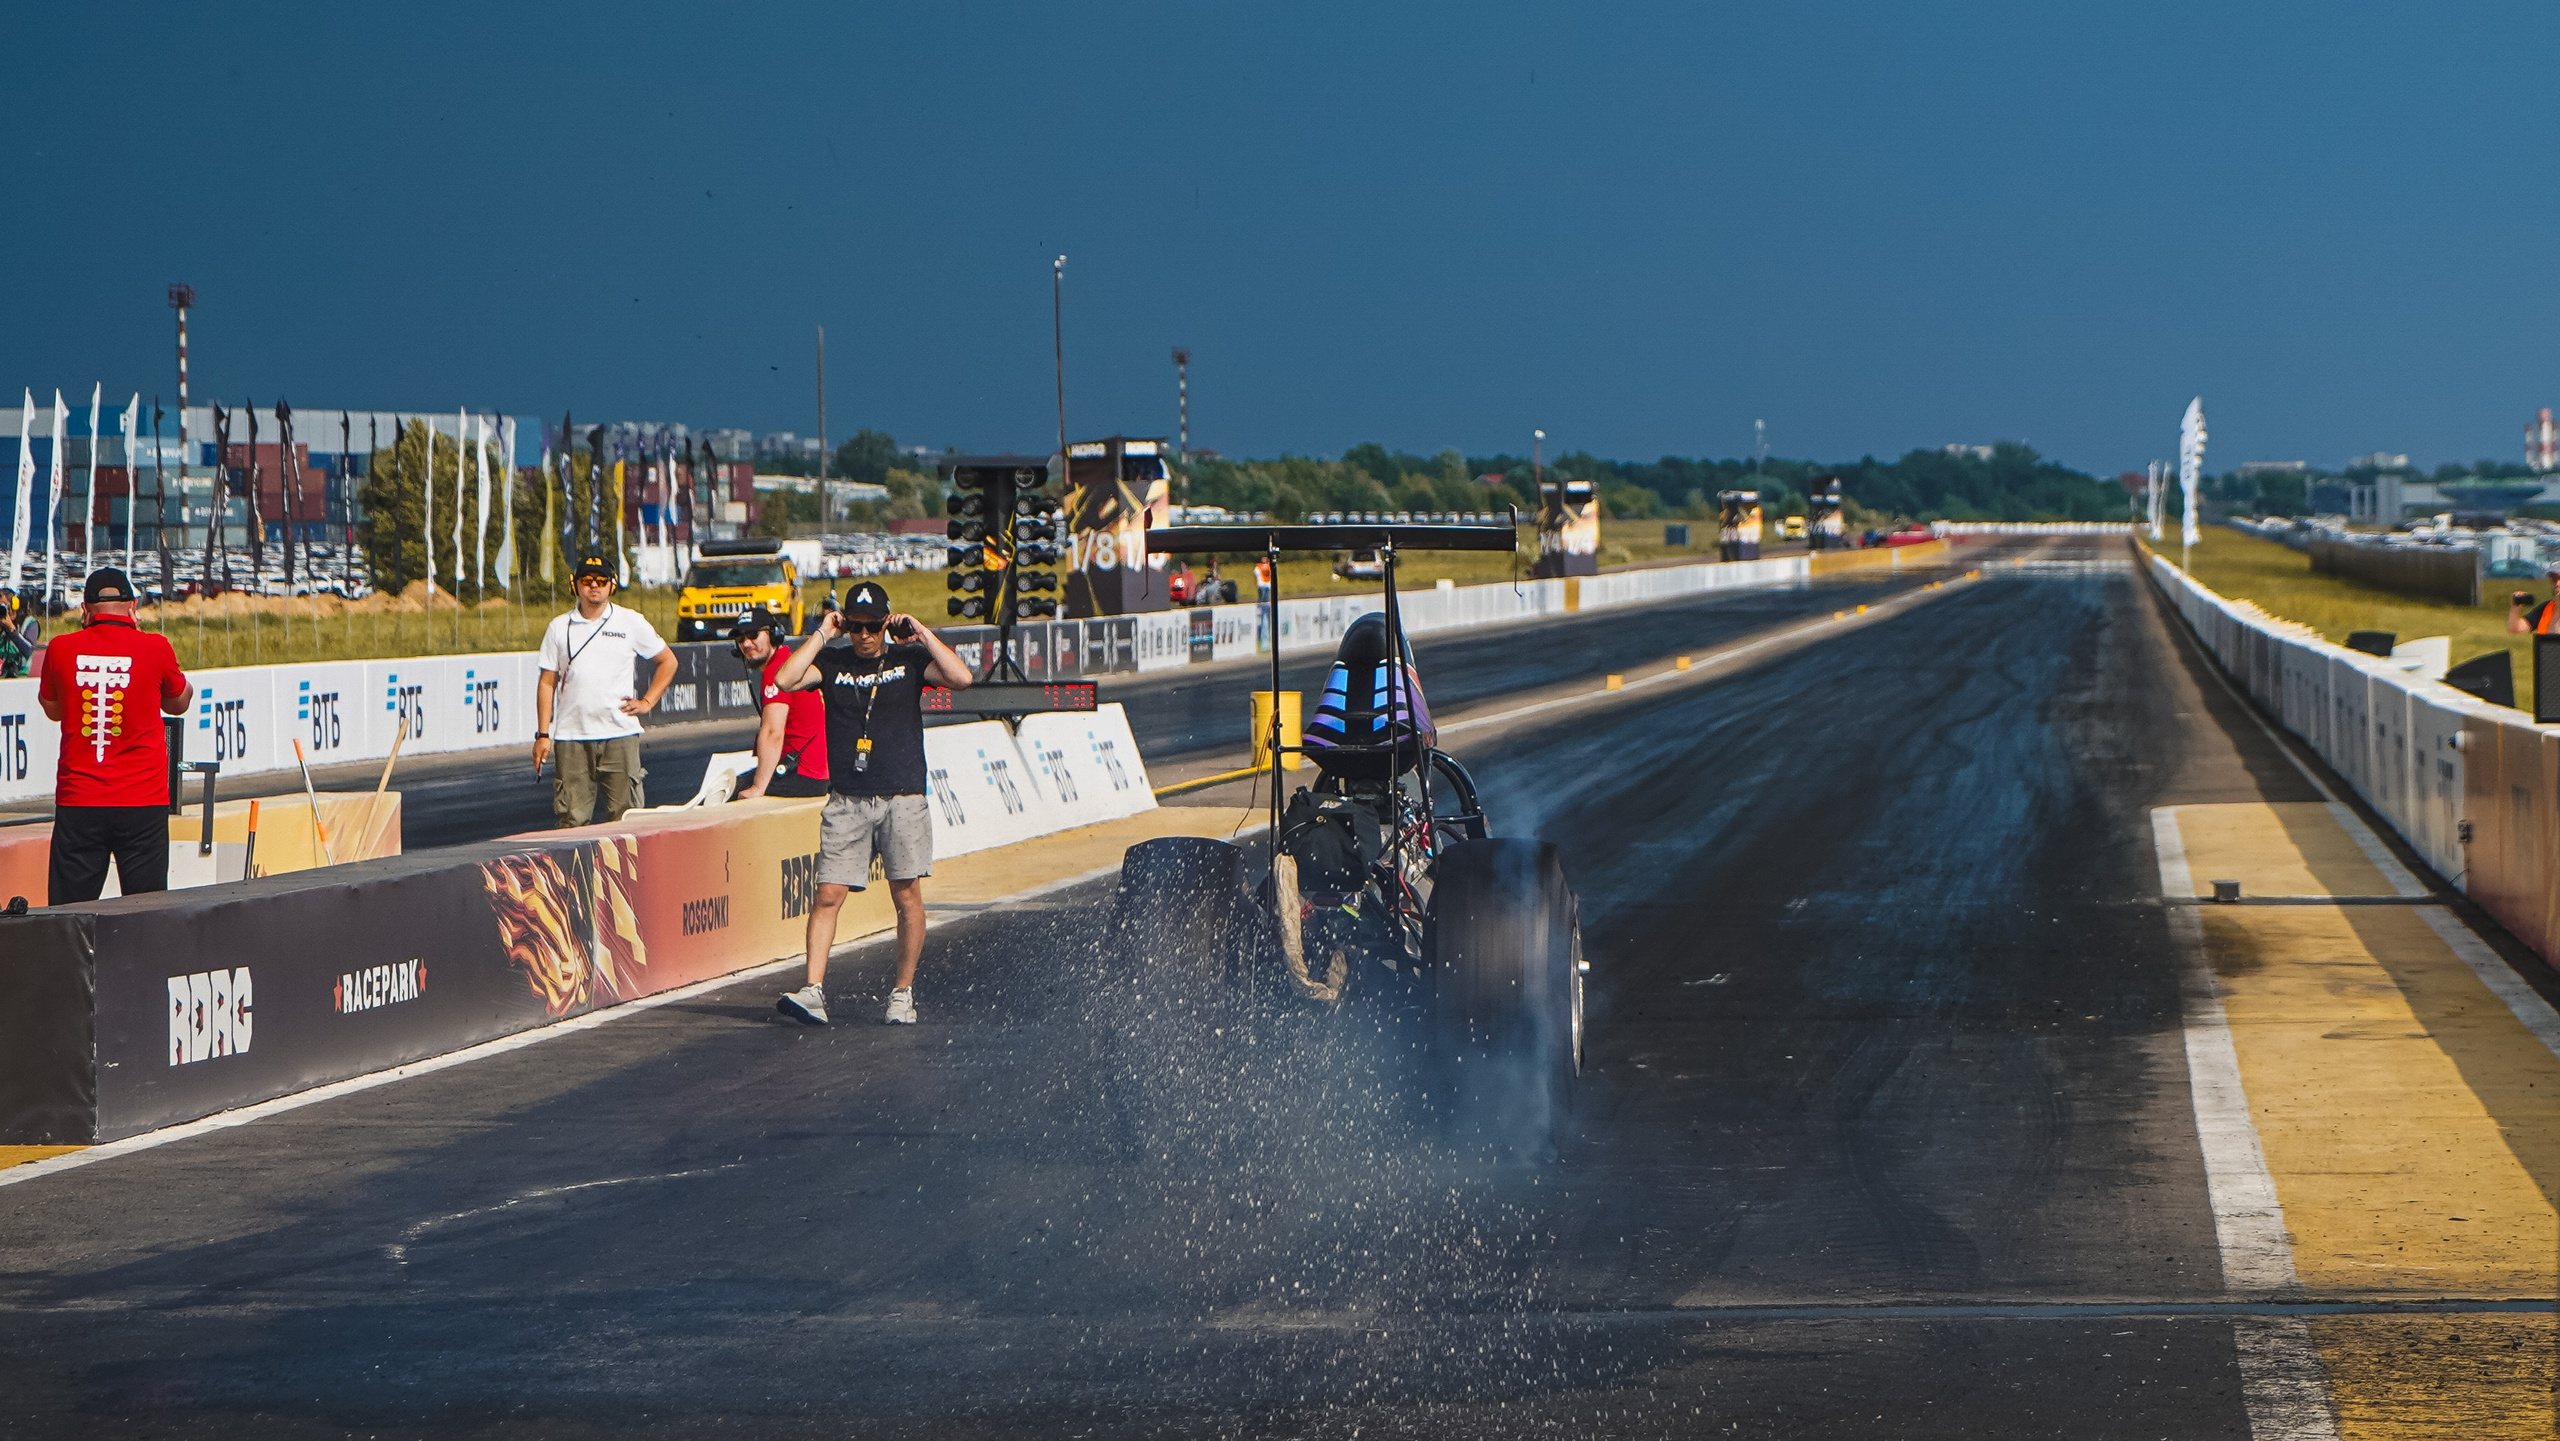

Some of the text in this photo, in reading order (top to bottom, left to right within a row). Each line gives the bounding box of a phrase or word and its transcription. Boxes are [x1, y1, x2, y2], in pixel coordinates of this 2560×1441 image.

[1066, 530, 1117, 572] 1/8
[215, 699, 247, 761] ВТБ
[313, 692, 341, 750] ВТБ
[399, 685, 423, 740] ВТБ
[476, 680, 499, 733] ВТБ
[0, 714, 28, 781] ТБ
[1098, 740, 1129, 791] ВТБ
[930, 768, 966, 827] ВТБ
[990, 759, 1024, 815] ВТБ
[1046, 749, 1079, 803] ВТБ
[682, 895, 729, 937] ROSGONKI
[343, 958, 419, 1014] RACEPARK
[168, 966, 252, 1066] RDRC
